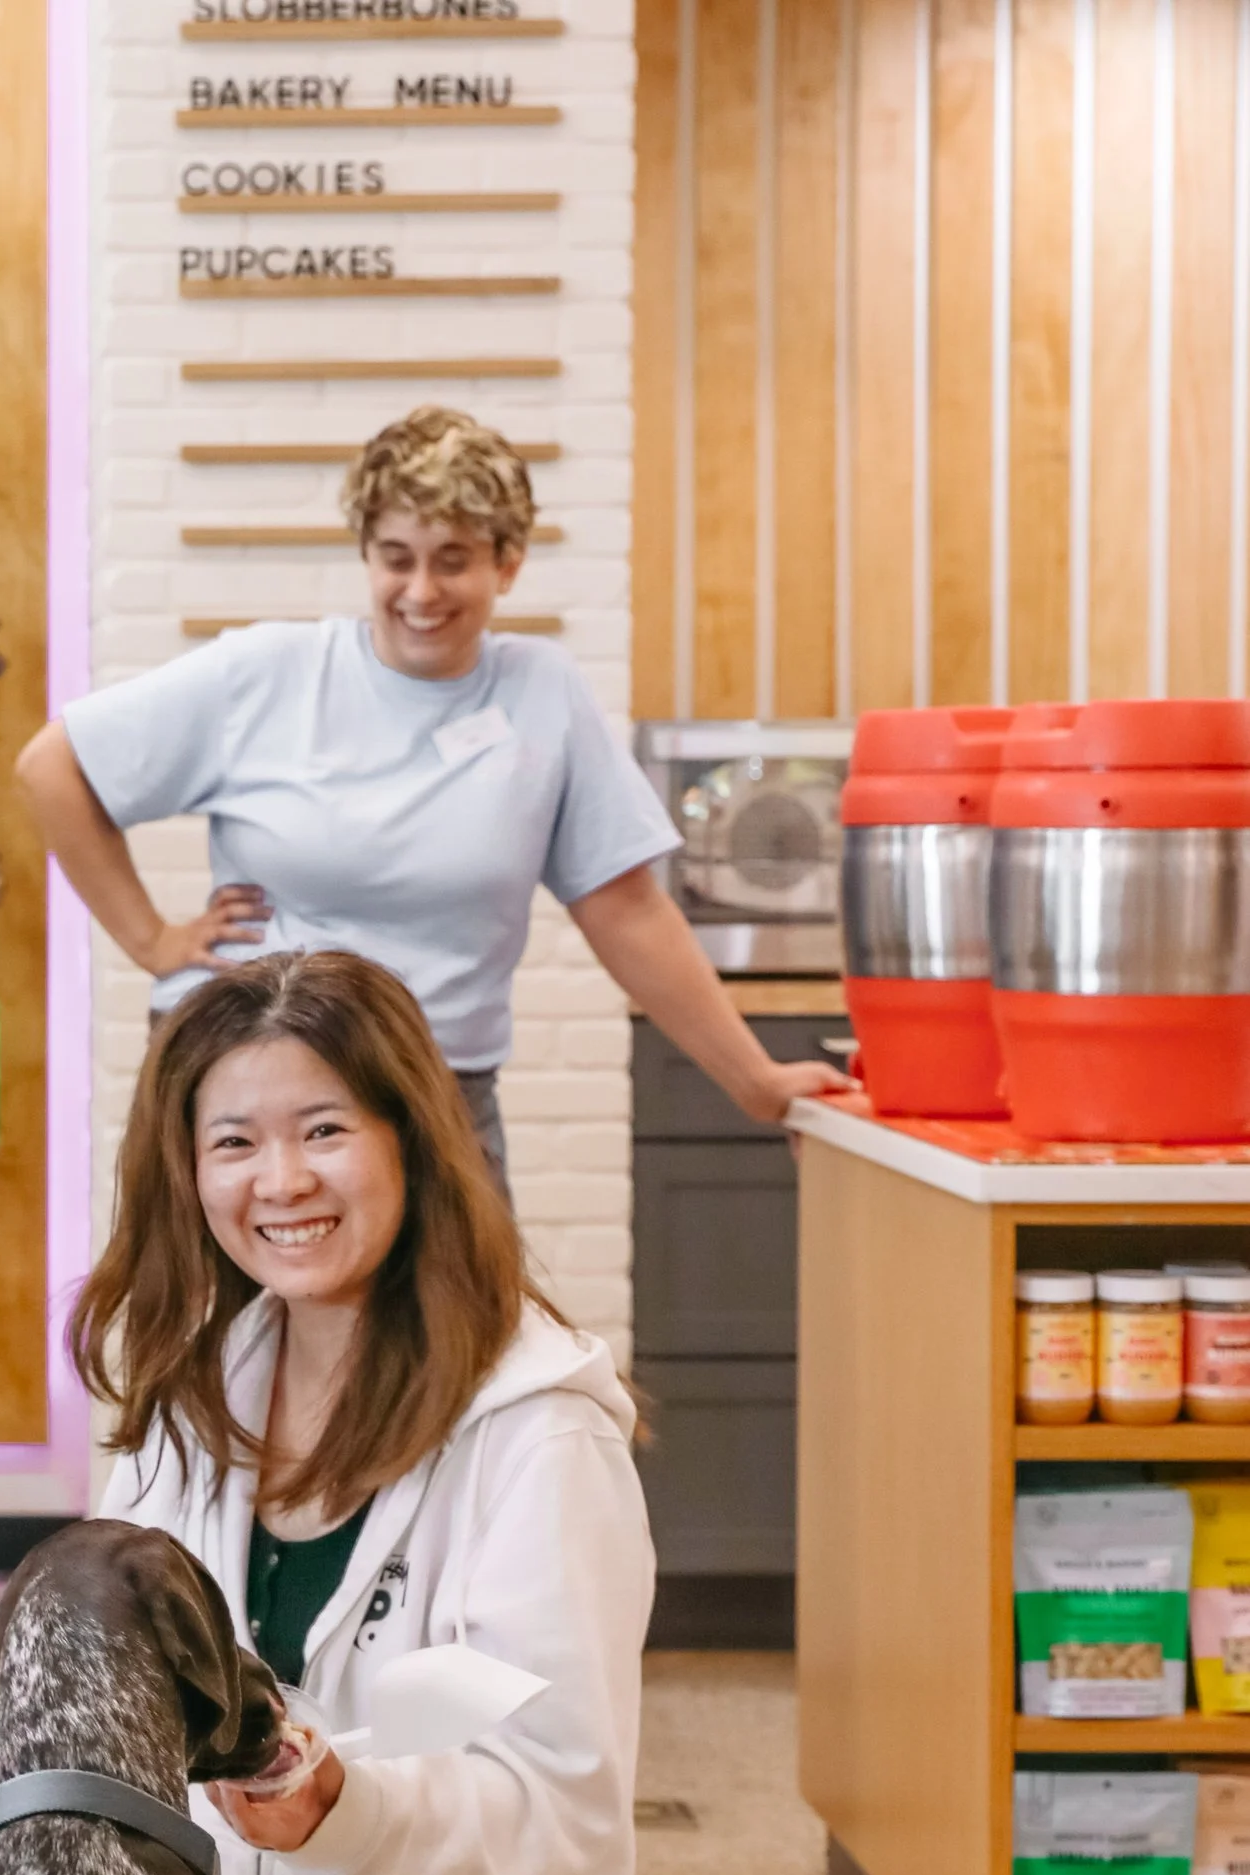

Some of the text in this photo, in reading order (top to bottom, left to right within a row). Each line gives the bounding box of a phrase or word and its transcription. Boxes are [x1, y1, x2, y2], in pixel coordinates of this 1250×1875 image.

[193, 0, 519, 22] SLOBBERBONES
[189, 74, 513, 110] BAKERY MENU
[181, 162, 386, 196] COOKIES
[180, 247, 395, 280] PUPCAKES
